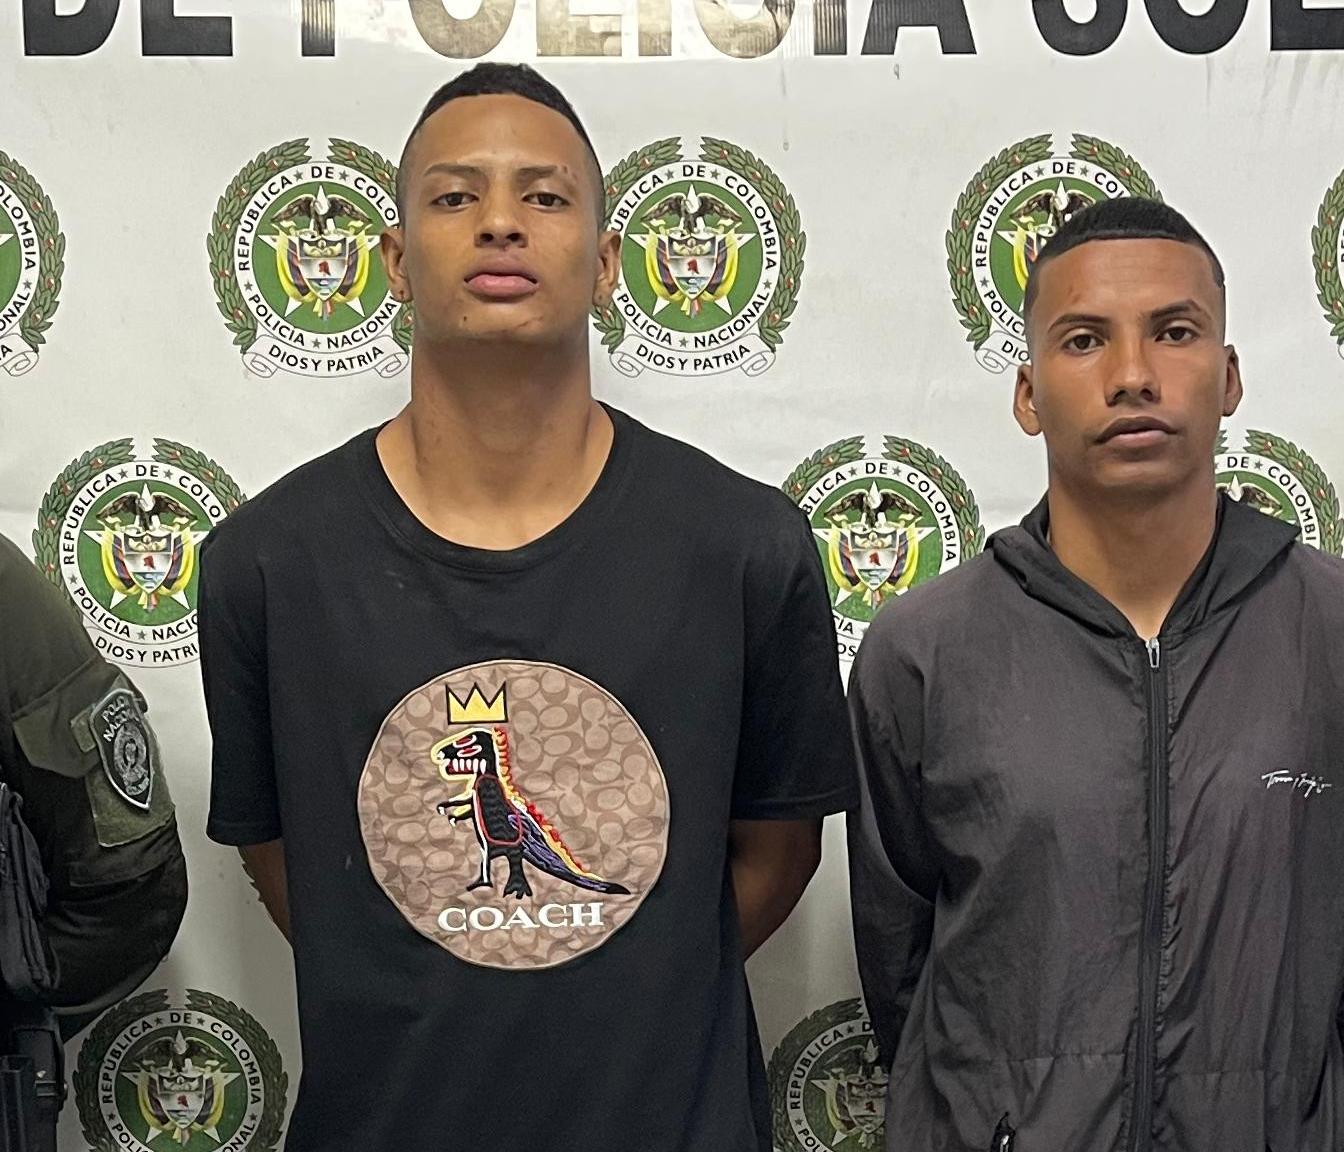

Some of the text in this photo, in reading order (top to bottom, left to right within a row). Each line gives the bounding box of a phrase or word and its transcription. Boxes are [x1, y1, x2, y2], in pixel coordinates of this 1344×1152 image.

[1052, 161, 1076, 175] DE
[311, 166, 334, 179] DE
[354, 176, 397, 221] COLO
[682, 164, 706, 178] DE
[725, 175, 777, 270] COLOMBIA
[326, 302, 397, 348] NACIONA
[693, 292, 770, 347] NACIONAL
[983, 290, 1024, 334] POLIC
[327, 346, 384, 372] PATRIA
[693, 344, 750, 371] PATRIA
[1001, 340, 1030, 362] DIO
[136, 464, 159, 477] DE
[178, 475, 221, 518] COLO
[801, 462, 956, 562] BLICA DE COLOMBIA
[1227, 456, 1316, 545] DE COLOMBI
[152, 641, 202, 662] PATRI
[437, 902, 604, 932] COACH
